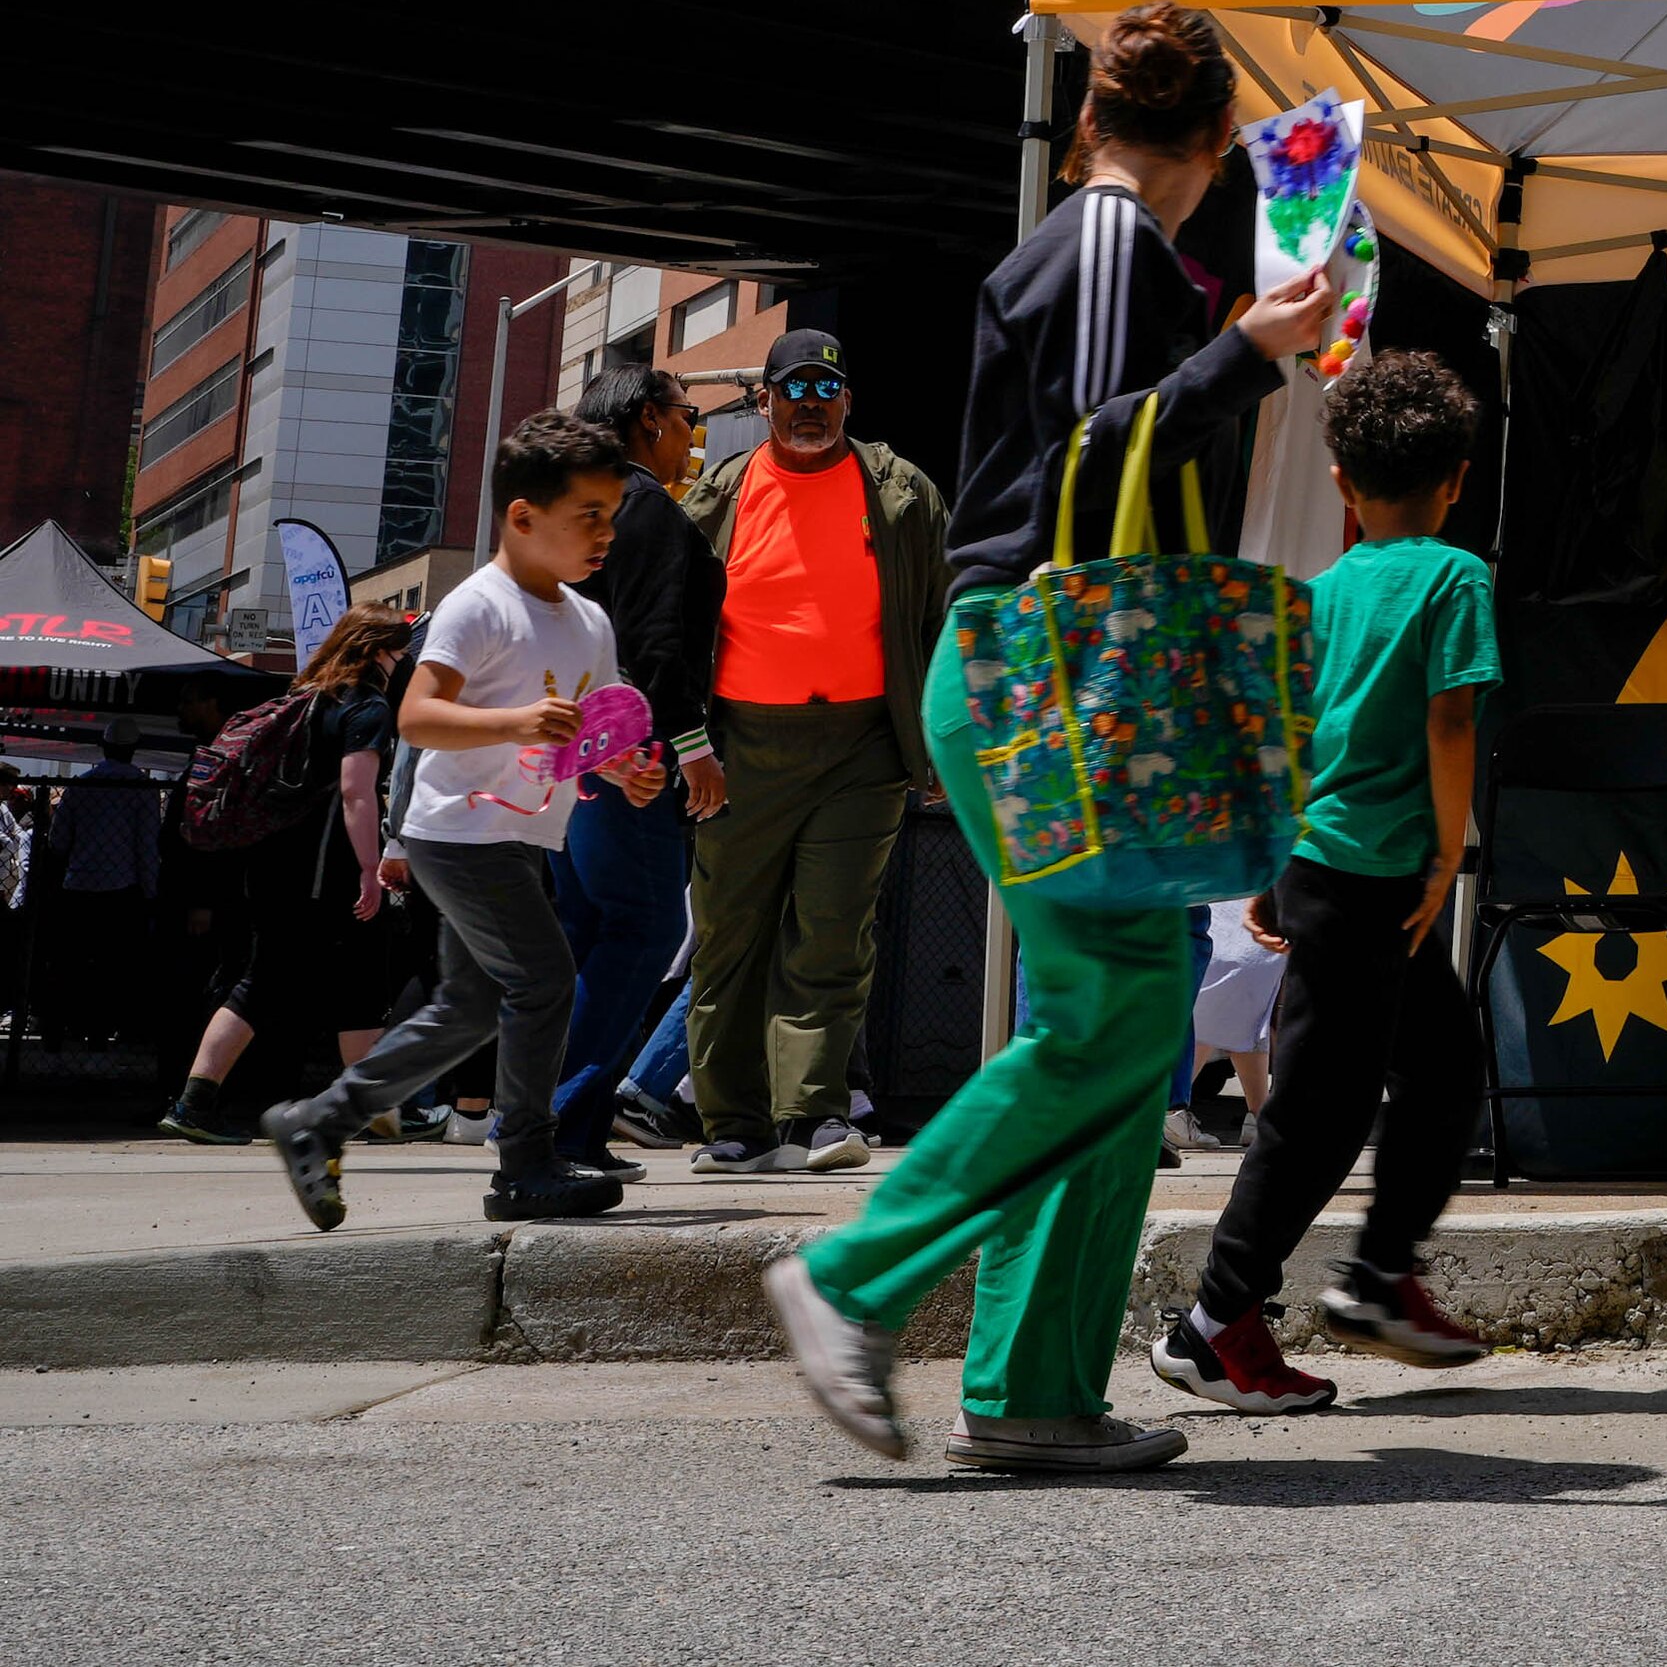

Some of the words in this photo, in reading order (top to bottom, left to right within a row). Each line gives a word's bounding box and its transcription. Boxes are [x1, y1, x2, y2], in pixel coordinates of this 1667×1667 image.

[243, 613, 256, 621] NO
[0, 612, 134, 647] TLR
[239, 622, 260, 630] TURN
[38, 636, 66, 644] LIVE
